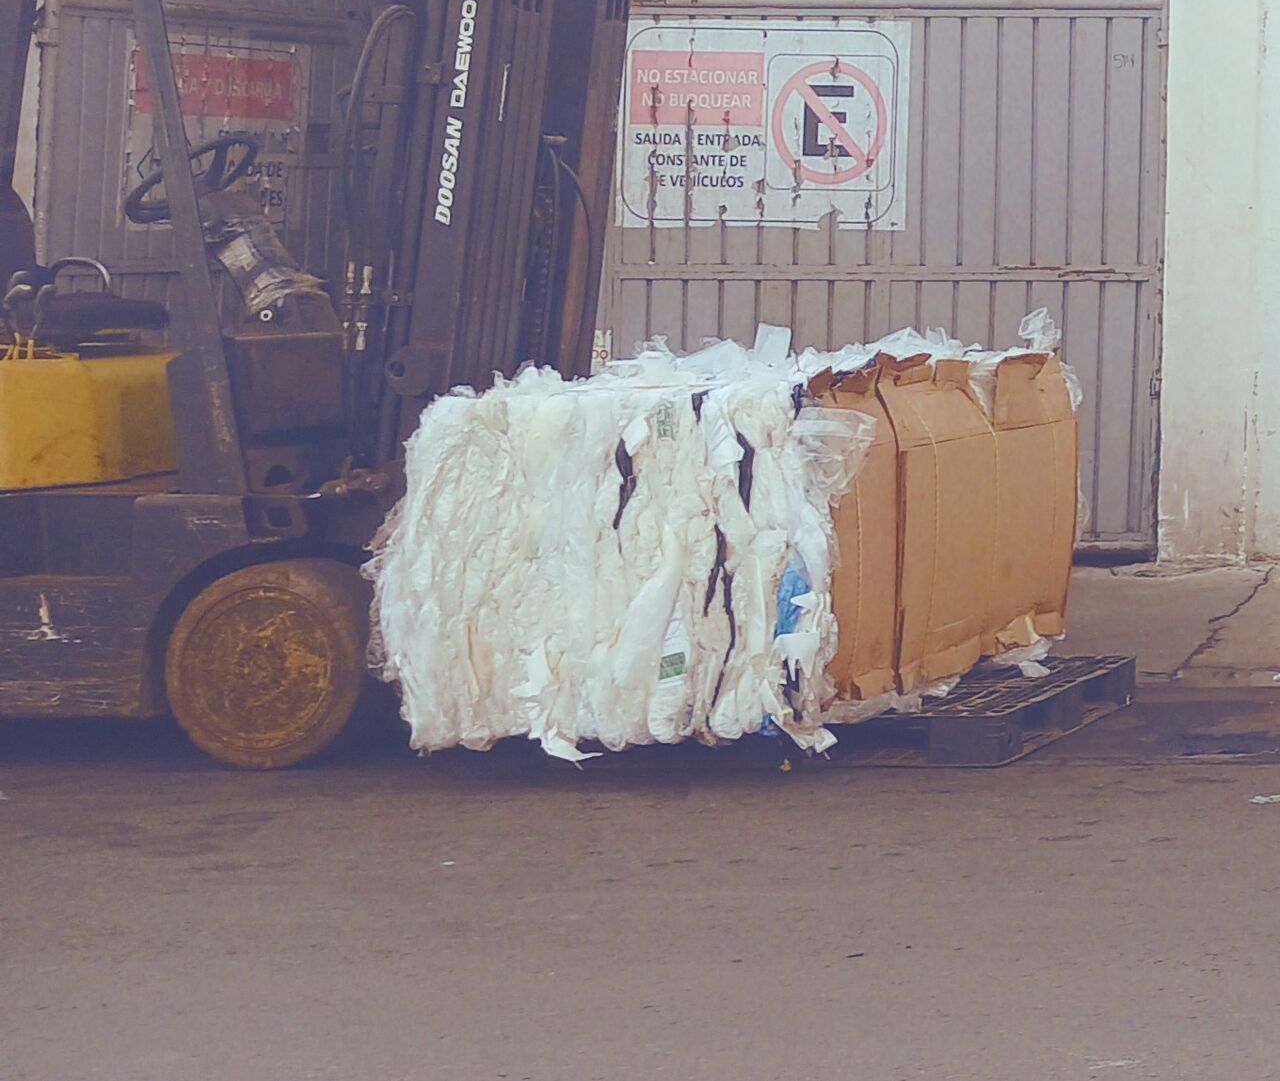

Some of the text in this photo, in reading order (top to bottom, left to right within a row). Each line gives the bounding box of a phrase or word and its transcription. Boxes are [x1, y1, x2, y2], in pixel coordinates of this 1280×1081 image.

[637, 69, 758, 85] NO ESTACIONAR
[642, 92, 752, 109] NO BLOQUEAR
[434, 0, 477, 226] DOOSAN DAEWOO
[634, 132, 682, 145] SALIDA
[647, 153, 747, 167] CONSANTE DE
